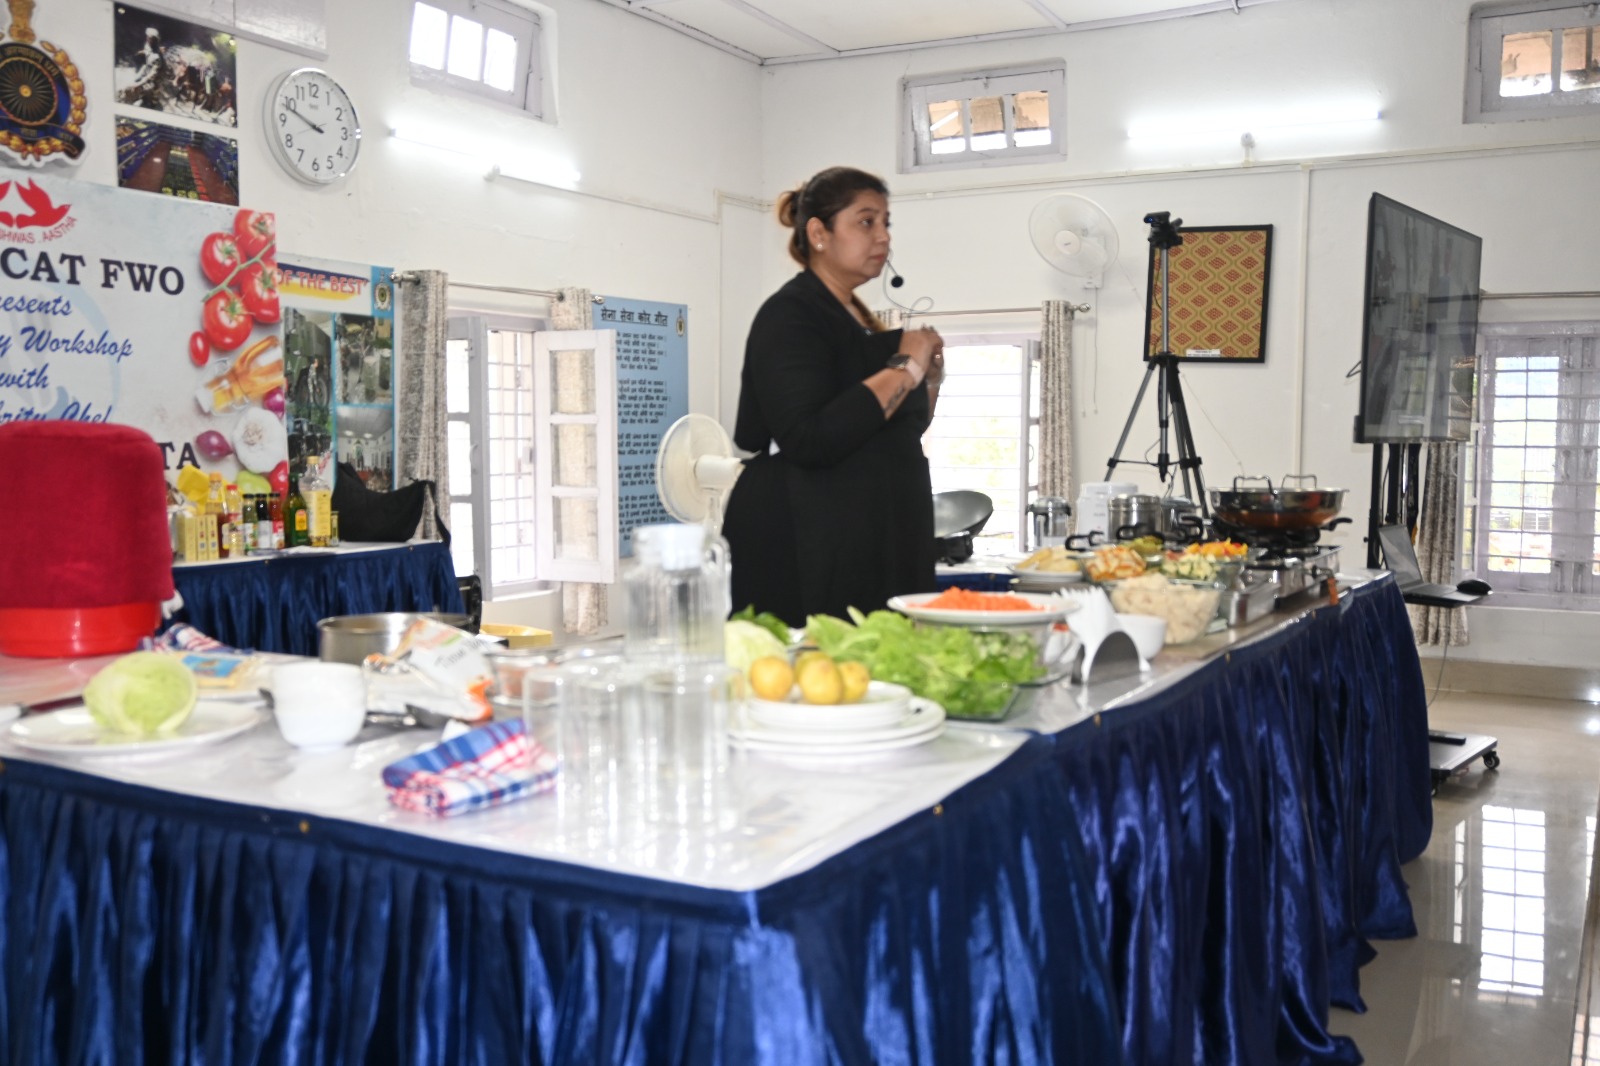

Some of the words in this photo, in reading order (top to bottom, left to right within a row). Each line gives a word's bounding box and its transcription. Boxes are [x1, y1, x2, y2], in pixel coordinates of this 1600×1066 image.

[295, 85, 305, 101] 11
[308, 82, 319, 98] 12
[285, 96, 297, 111] 10
[326, 91, 331, 105] 1
[279, 113, 287, 127] 9
[335, 107, 343, 121] 2
[285, 134, 293, 148] 8
[341, 127, 348, 140] 3
[297, 149, 305, 162] 7
[336, 146, 343, 158] 4
[311, 158, 319, 171] 6
[326, 155, 333, 169] 5
[42, 216, 77, 242] AASTHA
[0, 247, 86, 285] CAT
[100, 258, 184, 295] FWO
[297, 271, 326, 291] THE
[0, 296, 72, 316] esents
[601, 306, 616, 321] सेना
[620, 308, 634, 322] सेवा
[638, 310, 651, 324] कोर
[654, 311, 668, 326] गीत
[20, 326, 133, 363] Workshop
[0, 363, 49, 388] with
